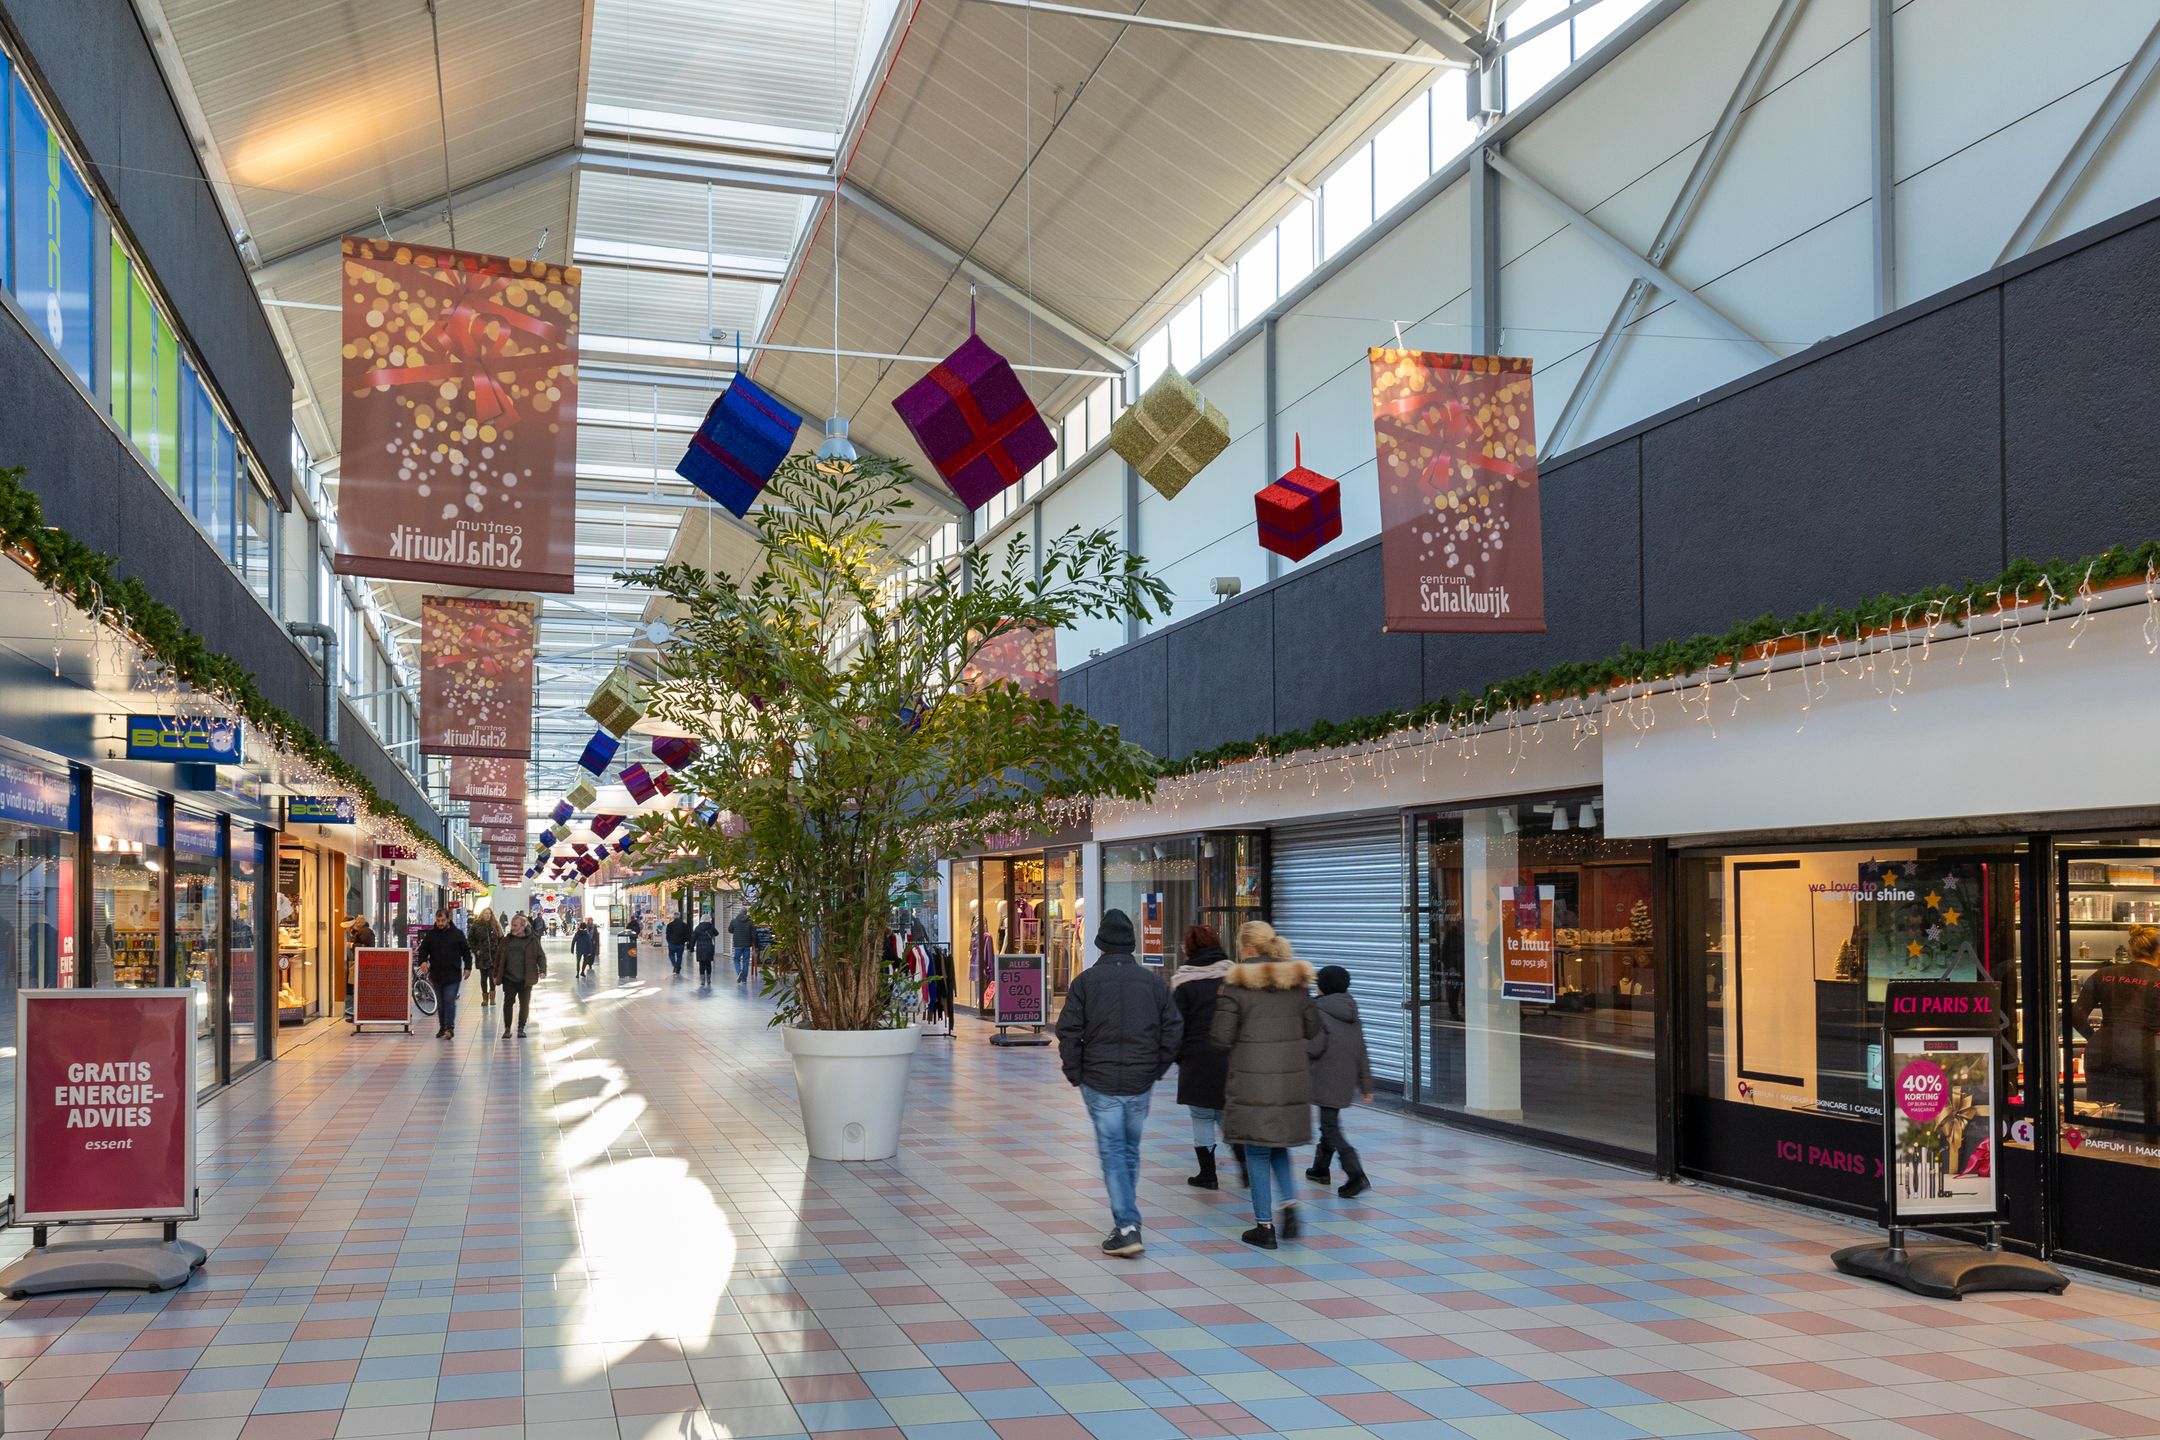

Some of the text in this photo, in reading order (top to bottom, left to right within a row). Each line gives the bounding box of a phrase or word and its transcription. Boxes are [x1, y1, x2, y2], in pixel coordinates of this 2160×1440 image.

[1420, 574, 1466, 584] centrum
[1420, 584, 1510, 618] Schalkwijk
[132, 729, 209, 748] BCC
[1809, 880, 1877, 892] we love to
[1847, 890, 1872, 904] you
[1876, 888, 1916, 900] shine
[1507, 936, 1550, 952] te huur
[1522, 959, 1536, 968] 7052
[1537, 959, 1548, 968] 383
[1000, 972, 1020, 983] €15
[2119, 976, 2148, 986] PARIS
[2153, 981, 2160, 989] X
[1008, 985, 1032, 996] €20
[1017, 998, 1040, 1009] €25
[1894, 997, 1992, 1013] ICI PARIS XL
[68, 1062, 151, 1083] GRATIS
[1902, 1075, 1942, 1092] 40%
[55, 1084, 164, 1106] ENERGIE-
[1814, 1099, 1848, 1111] SKINCARE
[66, 1107, 151, 1128] ADVIES
[2085, 1139, 2124, 1152] PARFUM
[1777, 1140, 1884, 1178] ICI PARIS X
